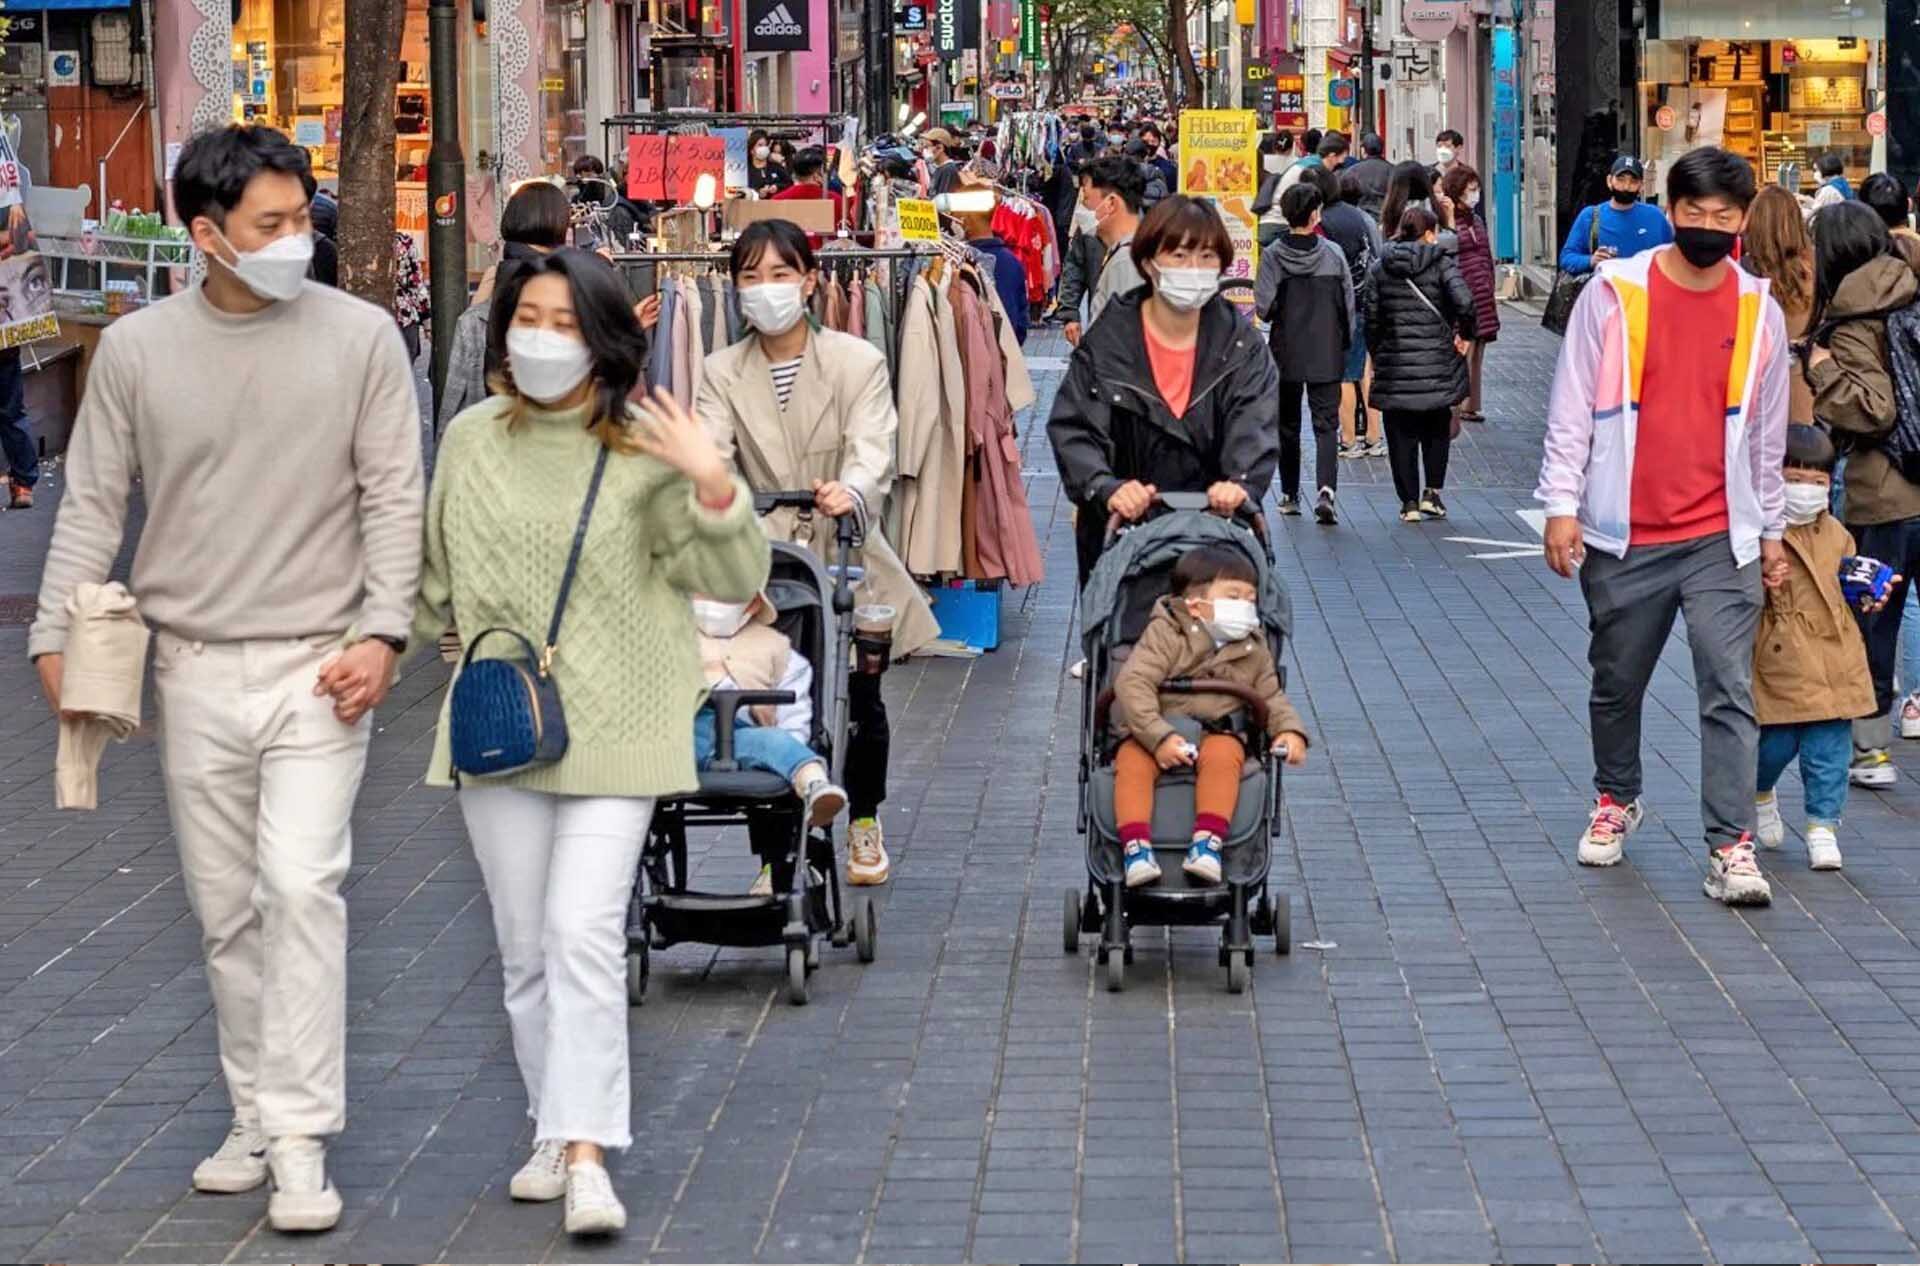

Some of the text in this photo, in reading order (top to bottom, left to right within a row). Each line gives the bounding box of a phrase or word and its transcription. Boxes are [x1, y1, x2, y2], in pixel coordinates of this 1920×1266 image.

[754, 24, 802, 36] adidas
[1187, 116, 1248, 134] Hikari
[1188, 134, 1248, 152] Massage
